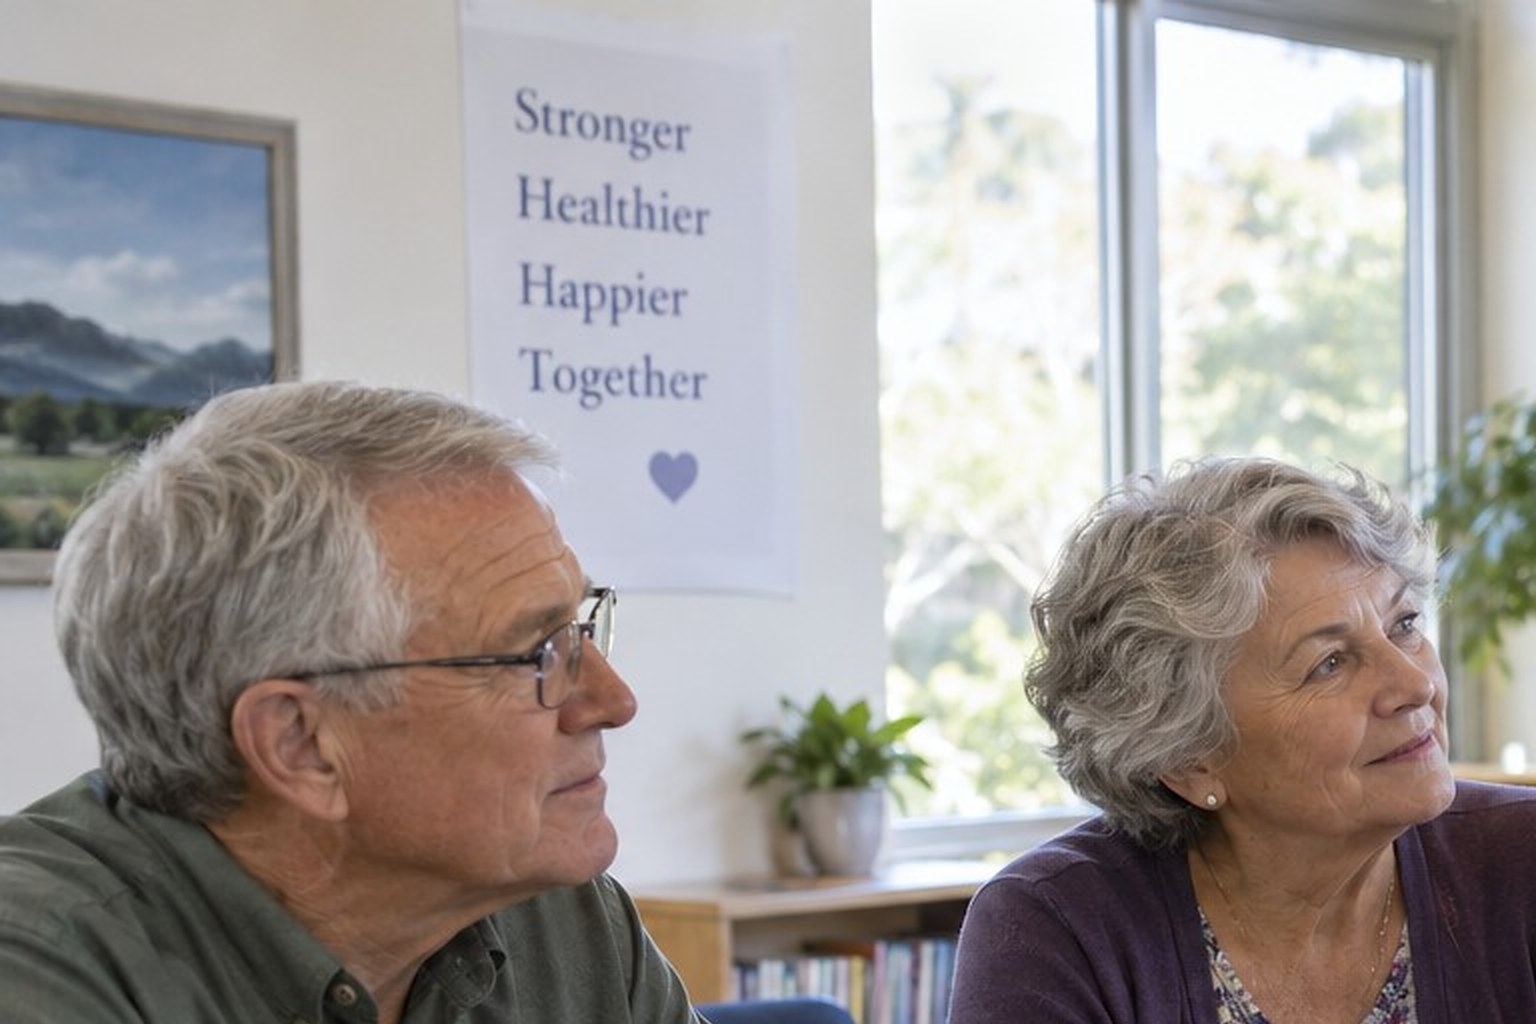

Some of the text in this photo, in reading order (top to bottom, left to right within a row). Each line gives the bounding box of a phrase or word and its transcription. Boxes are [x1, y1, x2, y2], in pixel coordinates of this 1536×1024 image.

[514, 87, 692, 162] Stronger
[517, 173, 711, 237] Healthier
[519, 261, 689, 328] Happier
[517, 346, 709, 411] Together
